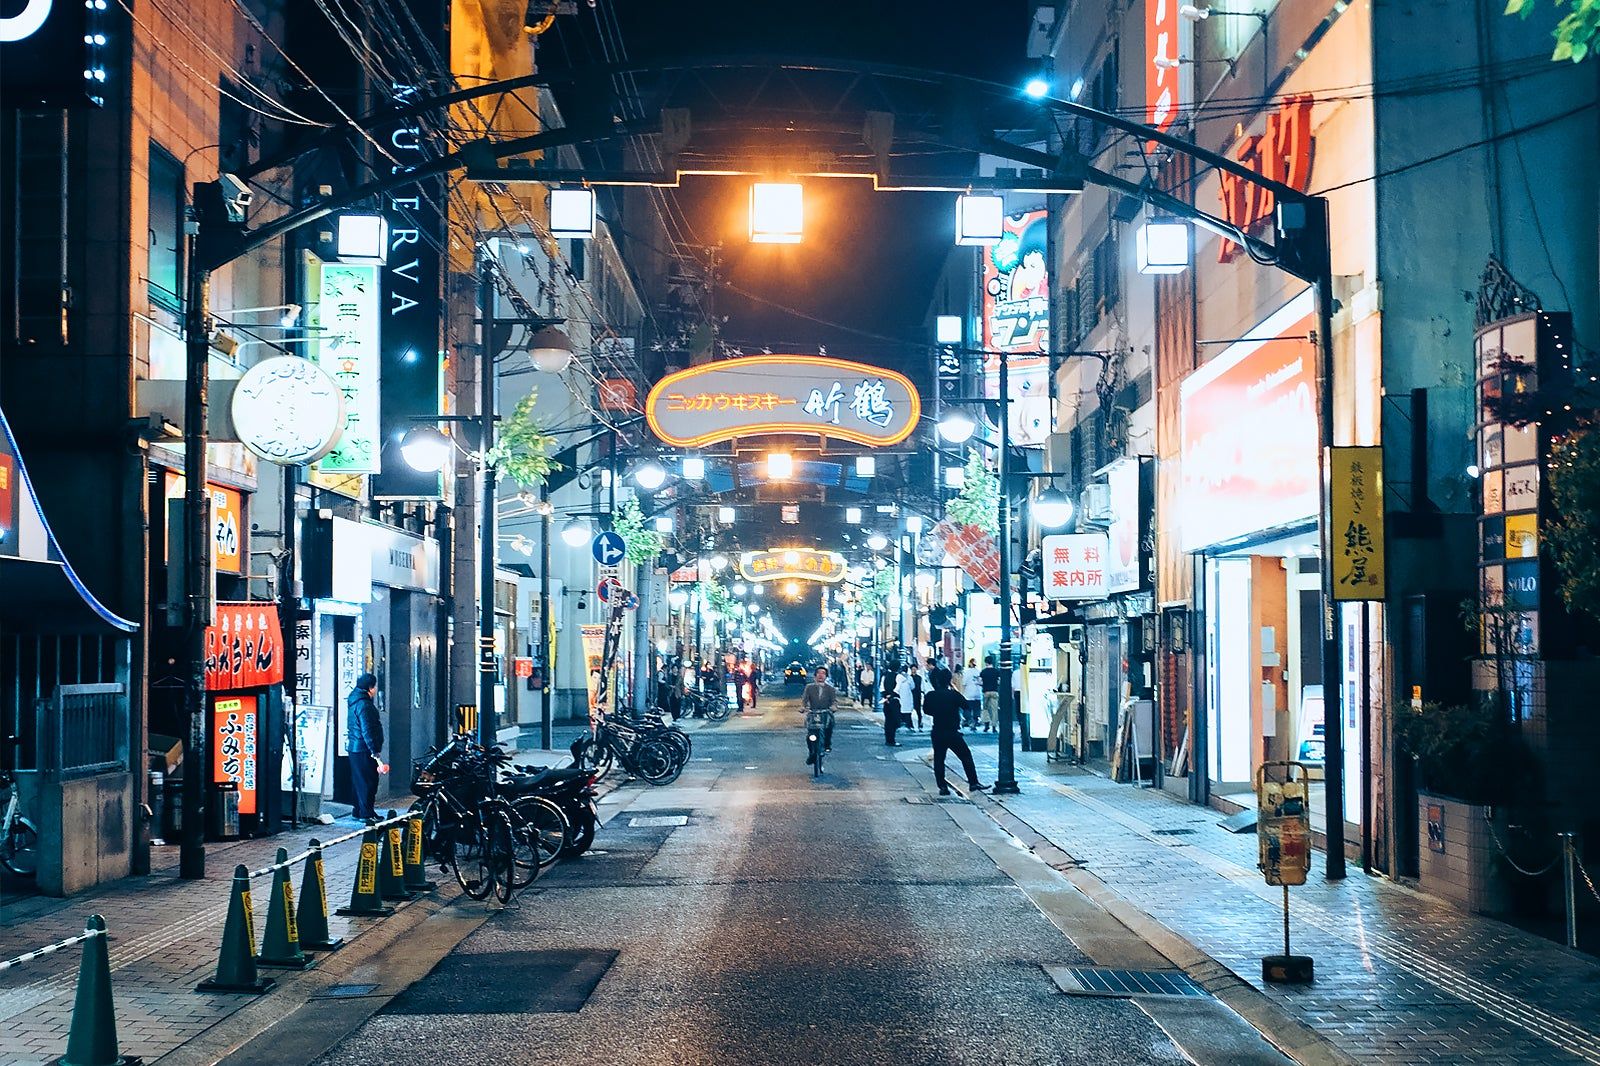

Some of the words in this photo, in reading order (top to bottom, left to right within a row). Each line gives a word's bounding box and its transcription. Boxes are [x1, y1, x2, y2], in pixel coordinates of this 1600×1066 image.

[667, 392, 797, 411] ニッカウヰスキー
[801, 379, 894, 428] 竹鶴
[1054, 546, 1100, 563] 無料
[1341, 521, 1373, 585] 熊屋
[1053, 569, 1102, 587] 案内所
[1508, 576, 1537, 592] SOLO
